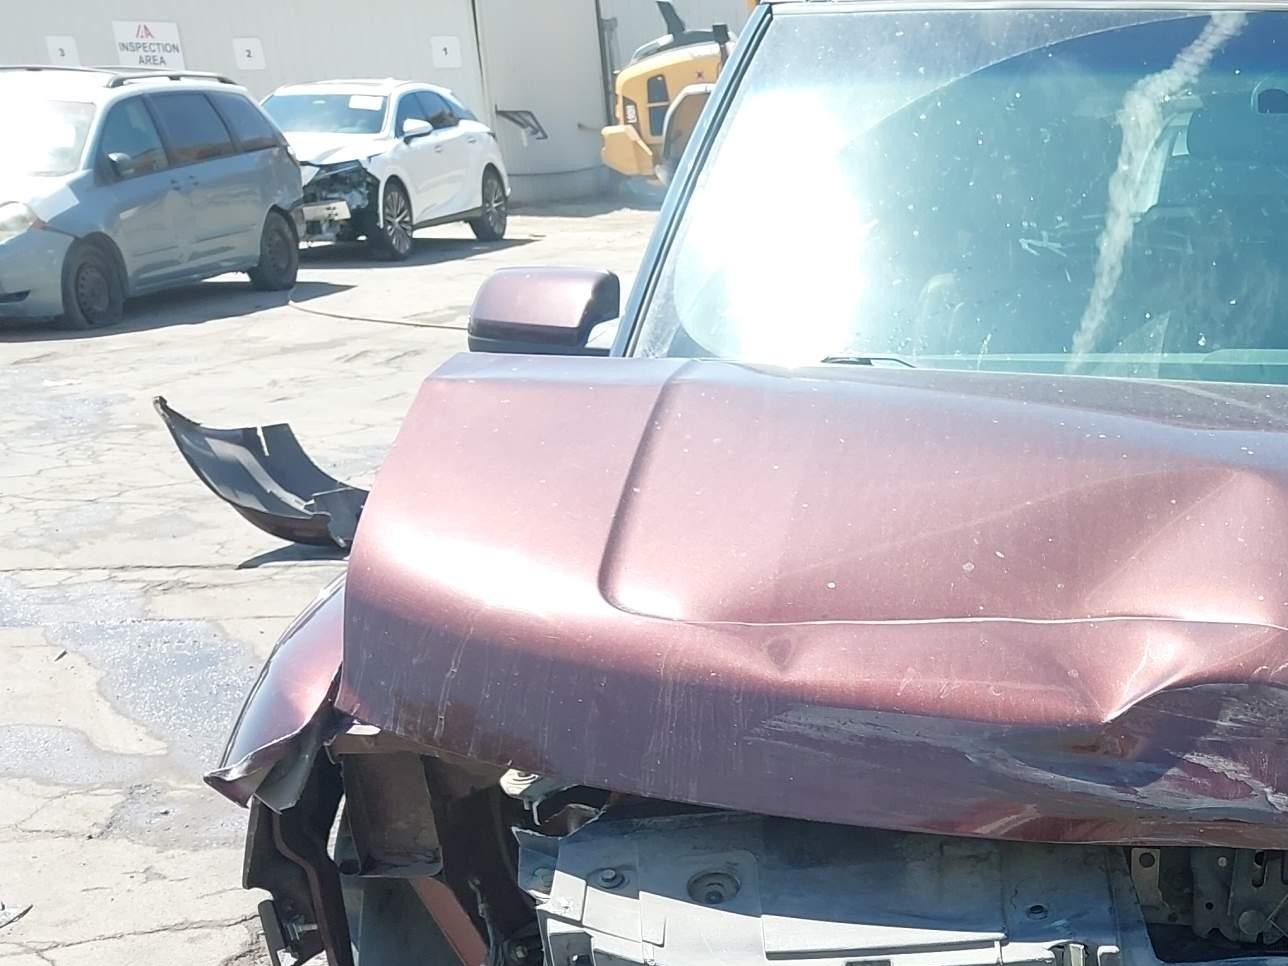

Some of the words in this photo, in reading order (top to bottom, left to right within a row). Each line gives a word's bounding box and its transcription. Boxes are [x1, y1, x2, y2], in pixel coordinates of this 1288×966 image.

[118, 41, 180, 54] INSPECTION
[245, 48, 253, 58] 2
[138, 55, 167, 66] AREA
